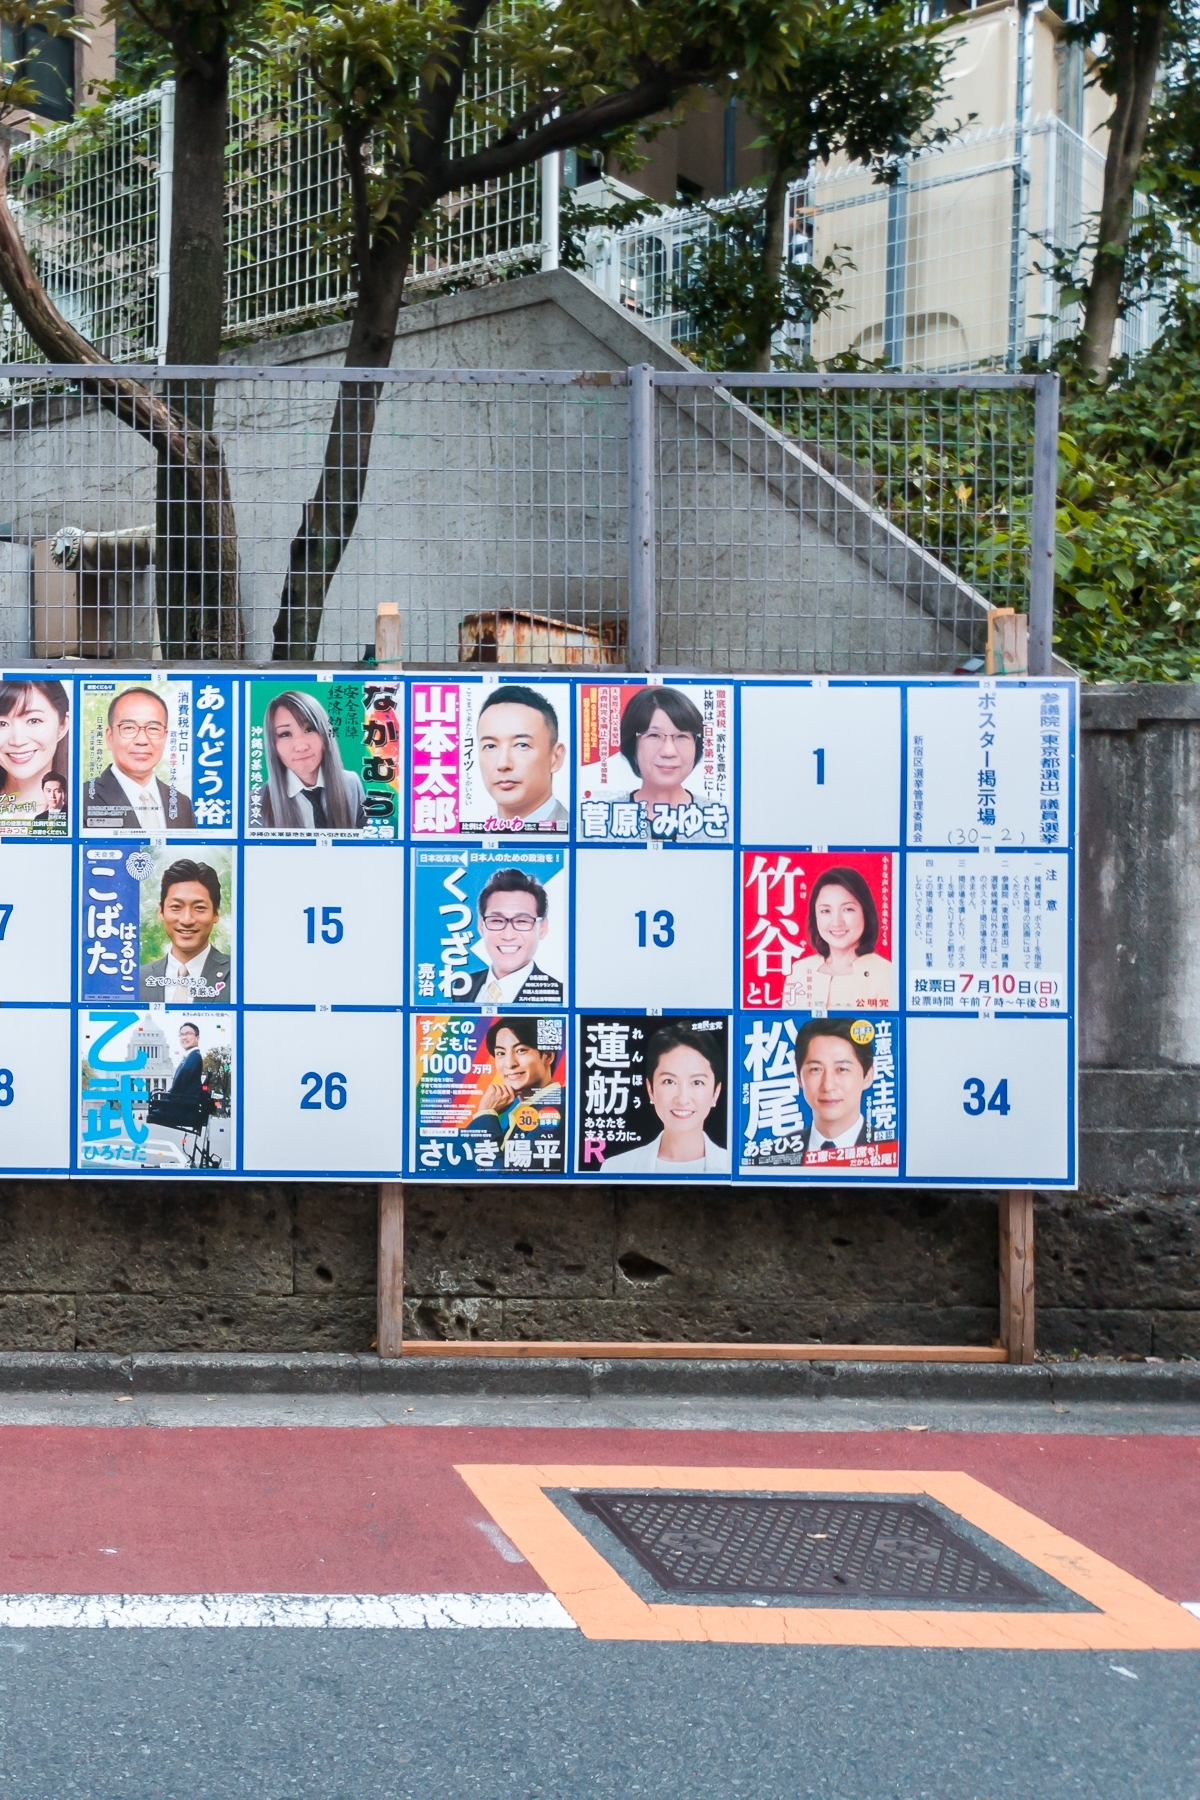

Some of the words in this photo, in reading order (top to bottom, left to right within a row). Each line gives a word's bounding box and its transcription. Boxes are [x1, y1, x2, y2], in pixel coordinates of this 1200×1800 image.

[328, 686, 343, 738] 経済効果
[343, 685, 359, 739] 安全保障
[194, 685, 226, 825] あんどう裕
[361, 685, 399, 818] なかむら
[413, 686, 457, 833] 山本太郎
[813, 748, 824, 784] 1
[977, 692, 996, 826] ポスター掲示場
[250, 726, 263, 826] 沖縄の基地を東京へ
[913, 735, 923, 843] 新宿区選挙管理委員会
[484, 816, 525, 831] れいわ
[581, 802, 639, 838] 菅原
[652, 802, 729, 838] みゆき
[420, 854, 460, 863] 日本改革党
[800, 882, 807, 899] たけ
[87, 867, 124, 975] こばた
[304, 907, 343, 944] 15
[438, 867, 474, 998] くつざわ
[635, 910, 674, 948] 13
[745, 855, 806, 977] 竹谷
[119, 923, 137, 992] はるひこ
[146, 977, 207, 987] 全てのいのちの
[418, 963, 436, 997] 亮治
[747, 982, 806, 1006] とし子
[856, 999, 889, 1008] 公明党
[911, 996, 954, 1006] 投票時間
[420, 1020, 475, 1034] すべての
[420, 1037, 477, 1052] 子どもに
[82, 1012, 149, 1145] 乙武
[420, 1054, 492, 1074] 1000万円
[585, 1023, 631, 1115] 蓮舫
[632, 1028, 643, 1109] れんほう
[744, 1019, 804, 1140] 松尾
[872, 1020, 897, 1130] 立憲民主党
[300, 1072, 347, 1110] 26
[963, 1078, 1010, 1116] 34
[584, 1117, 626, 1128] あなたを
[584, 1130, 642, 1142] 支える力に。
[875, 1131, 894, 1140] 公認
[84, 1145, 147, 1161] ひろただ
[419, 1139, 500, 1167] さいき
[504, 1140, 561, 1168] 陽平
[584, 1136, 606, 1163] R
[744, 1136, 804, 1157] あきひろ
